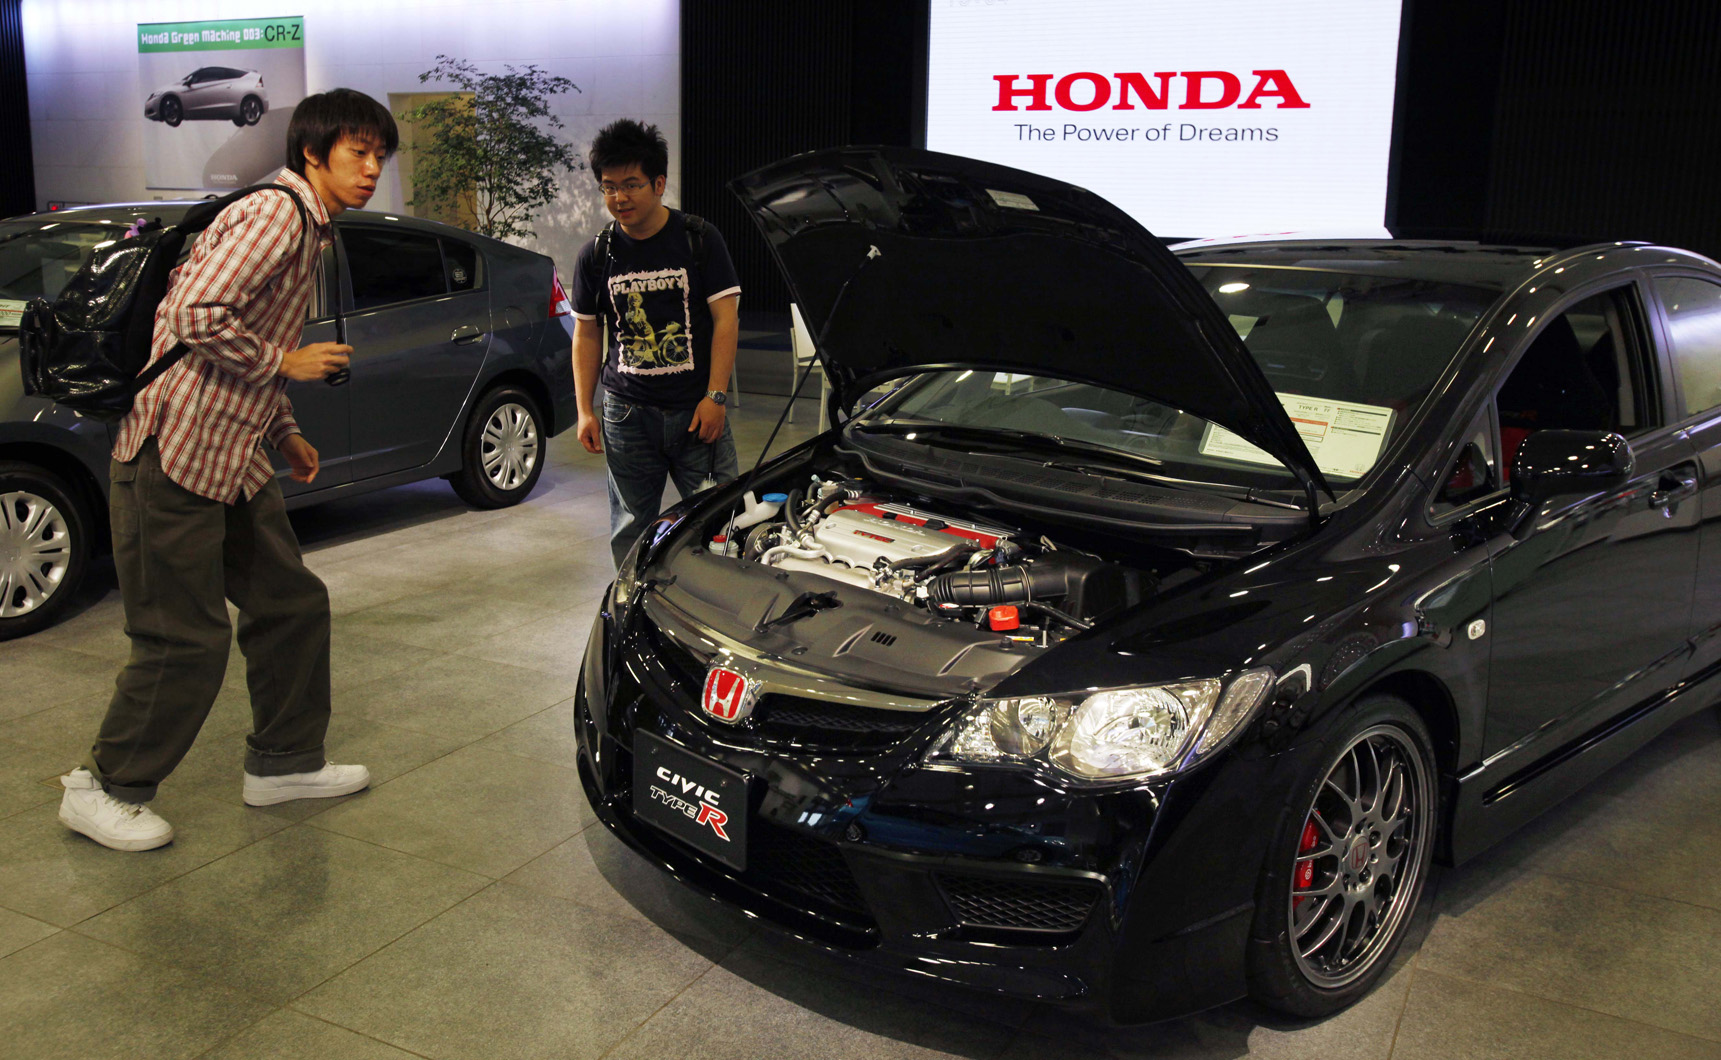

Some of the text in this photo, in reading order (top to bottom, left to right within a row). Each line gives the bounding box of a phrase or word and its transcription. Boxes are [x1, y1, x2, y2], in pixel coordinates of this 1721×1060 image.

[141, 31, 169, 45] Honda
[171, 31, 200, 45] Green
[264, 24, 301, 42] CR-Z
[992, 69, 1311, 112] HONDA
[1014, 123, 1279, 142] The Power of Dreams
[613, 278, 676, 295] PLAYBOY
[656, 766, 721, 806] CIVIC
[649, 785, 731, 842] TYPE R
